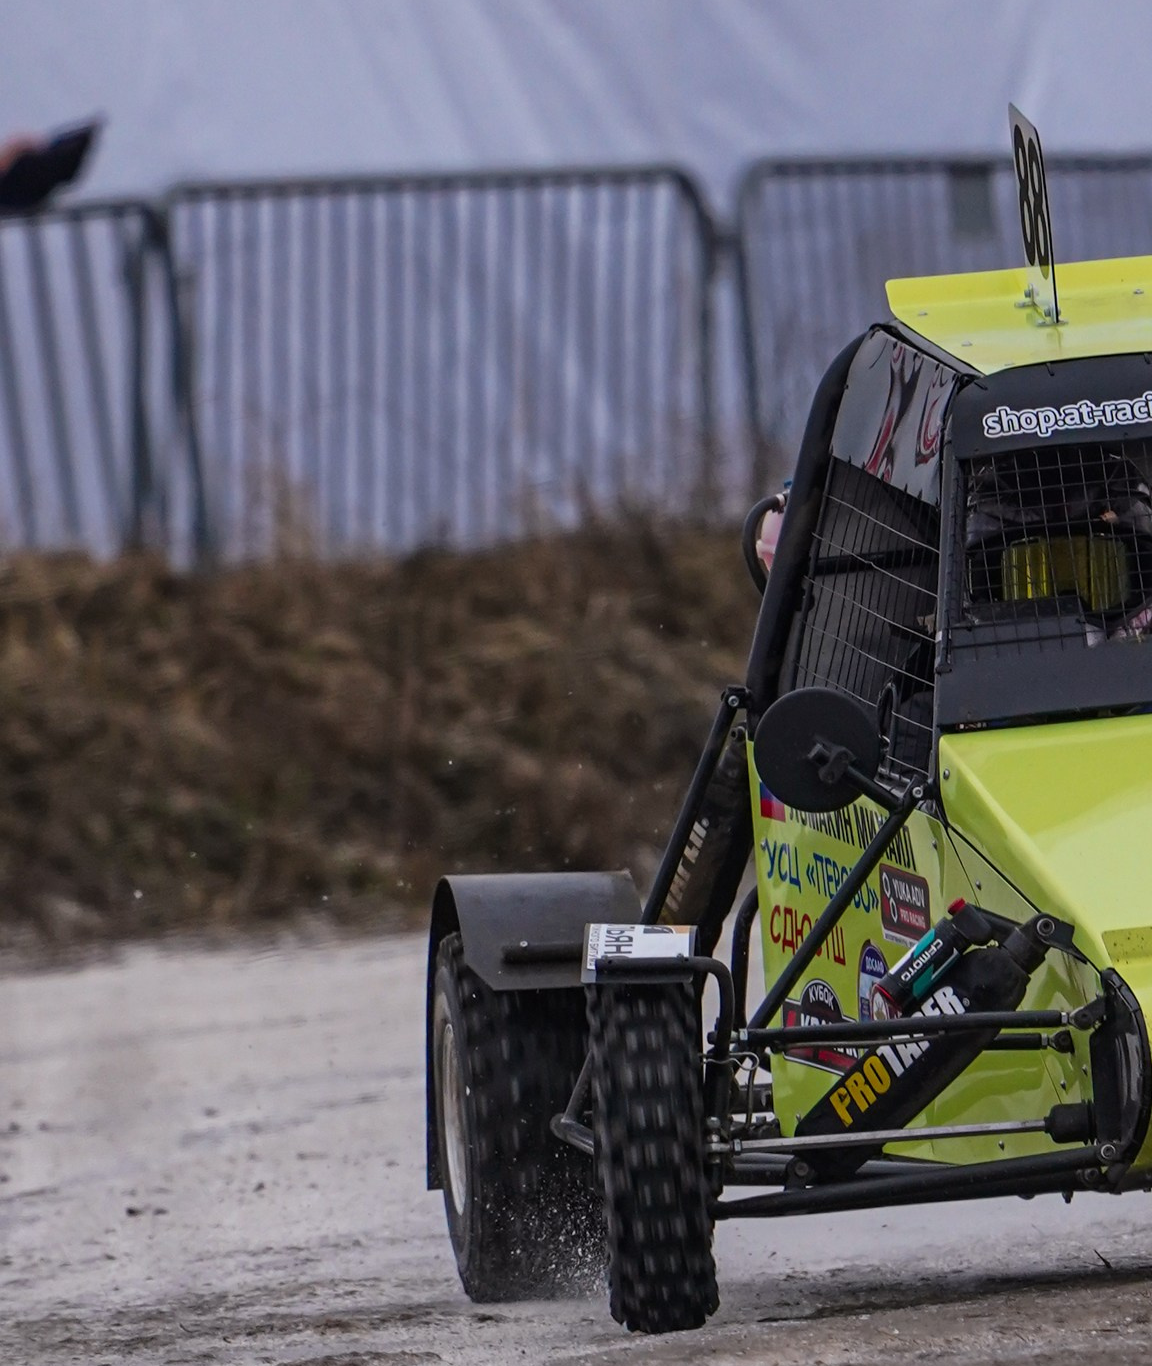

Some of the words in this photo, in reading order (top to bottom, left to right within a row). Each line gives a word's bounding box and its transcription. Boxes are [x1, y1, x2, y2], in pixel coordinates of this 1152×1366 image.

[1014, 124, 1050, 280] 88
[764, 837, 802, 893] УСЦ
[901, 938, 943, 982] CFMOTO
[808, 984, 834, 1011] КУБОК
